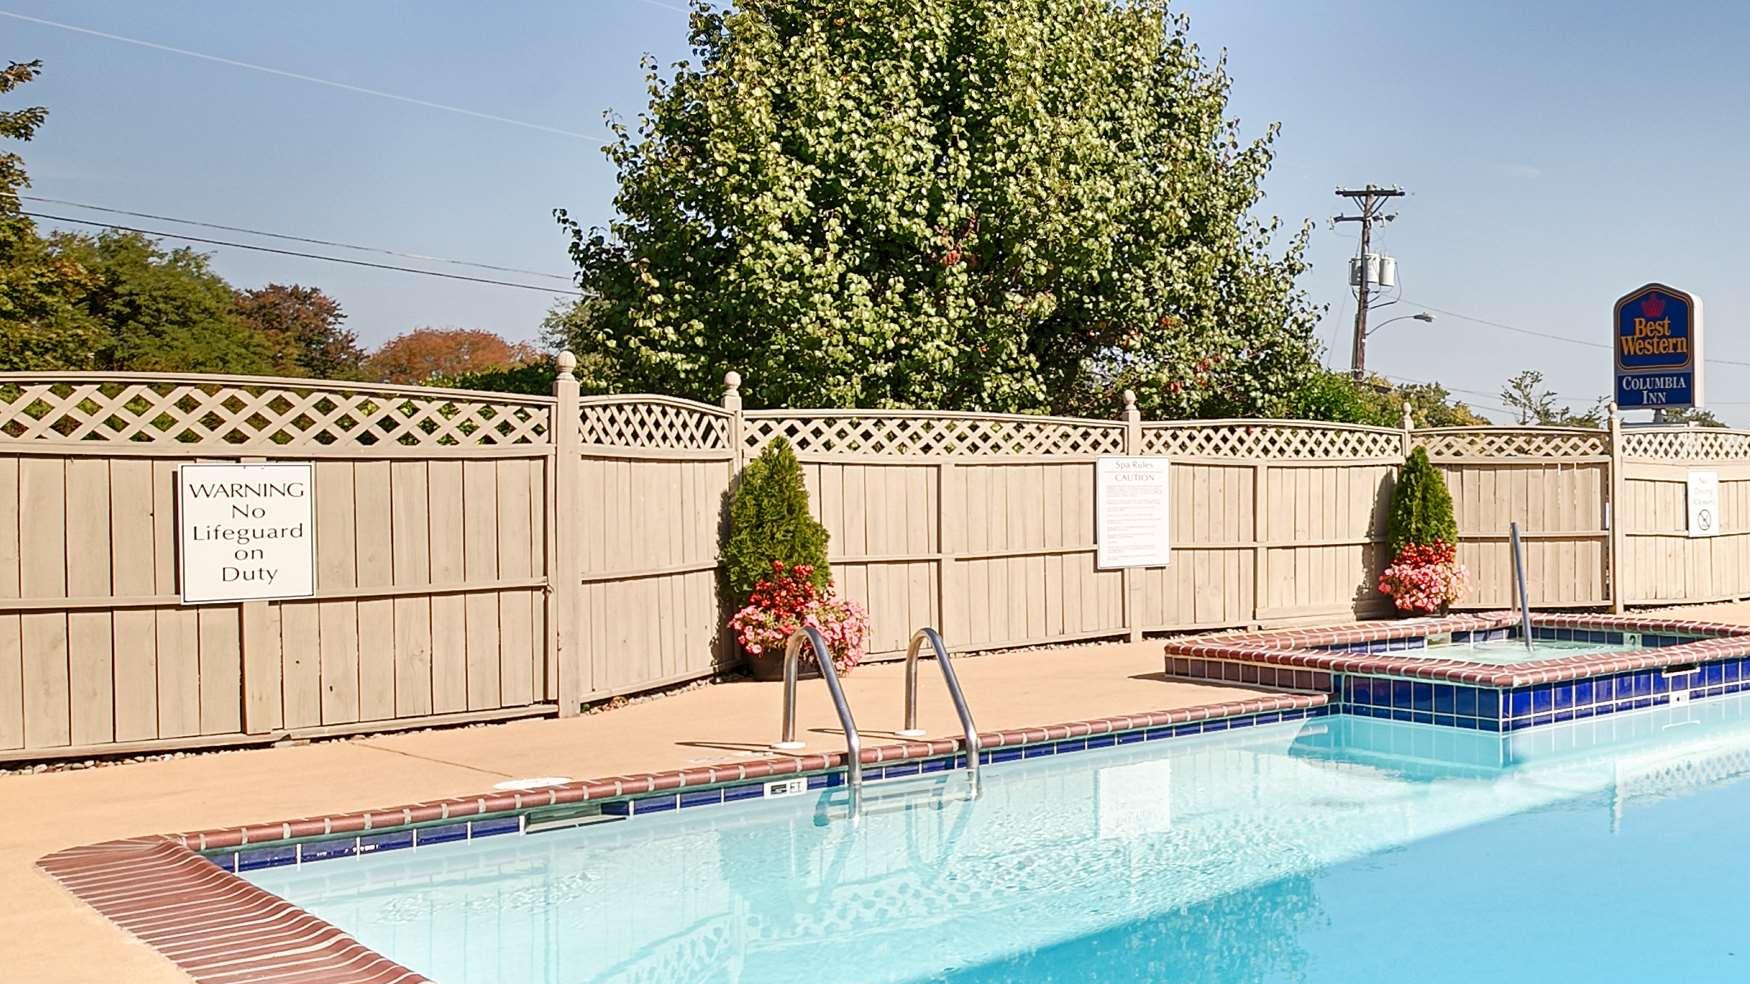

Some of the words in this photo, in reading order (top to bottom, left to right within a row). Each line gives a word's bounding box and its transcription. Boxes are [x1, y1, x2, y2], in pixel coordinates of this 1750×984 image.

[1633, 315, 1672, 338] Best
[1621, 335, 1688, 357] Western
[1622, 376, 1688, 391] COLUMBIA
[1642, 390, 1667, 404] INN
[1115, 460, 1131, 470] Spa
[1132, 461, 1154, 469] Rules
[1114, 473, 1155, 482] CAUTION
[188, 482, 304, 499] WARNING
[231, 503, 266, 519] No
[193, 522, 304, 545] Lifeguard
[234, 548, 264, 561] on
[222, 566, 278, 585] Duty
